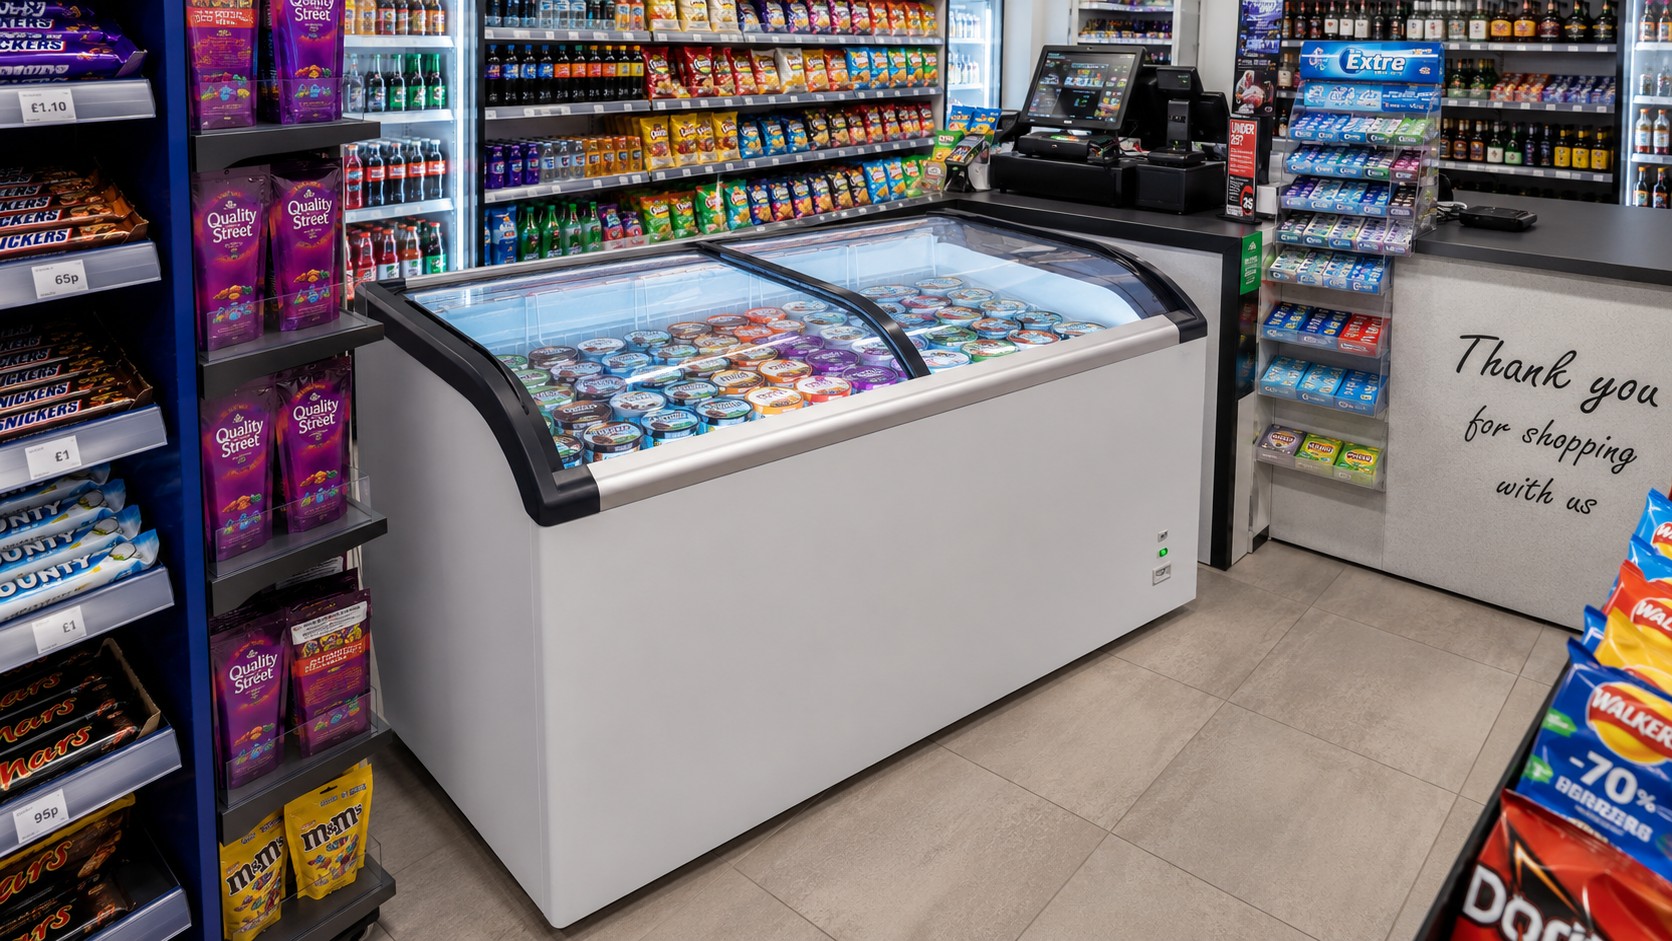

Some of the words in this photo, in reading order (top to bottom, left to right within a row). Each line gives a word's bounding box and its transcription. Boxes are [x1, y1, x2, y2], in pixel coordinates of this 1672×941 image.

[294, 7, 331, 21] Street
[0, 39, 62, 50] CKERS
[31, 101, 67, 113] £1.10
[0, 210, 59, 228] CKERS
[207, 208, 257, 230] Quality
[288, 199, 332, 217] Quality
[293, 212, 329, 230] Street
[0, 229, 68, 250] ICKERS
[212, 225, 252, 243] Street
[55, 273, 79, 285] 65p
[1456, 334, 1577, 389] Thank
[1580, 376, 1658, 414] you
[293, 399, 339, 423] Quality
[216, 419, 264, 444] Quality
[299, 413, 336, 435] Street
[221, 434, 260, 459] Street
[1464, 405, 1511, 442] for
[1522, 419, 1638, 475] shopping
[55, 449, 70, 462] £1
[1496, 477, 1554, 505] with
[1566, 496, 1598, 515] us
[0, 553, 91, 598] OUNTY
[62, 621, 77, 634] £1
[229, 653, 278, 682] Quality
[0, 672, 62, 709] ars
[234, 667, 273, 695] Street
[1592, 687, 1672, 751] WALKER
[1569, 750, 1657, 814] -70%
[34, 806, 59, 824] 95p
[0, 840, 73, 904] ars
